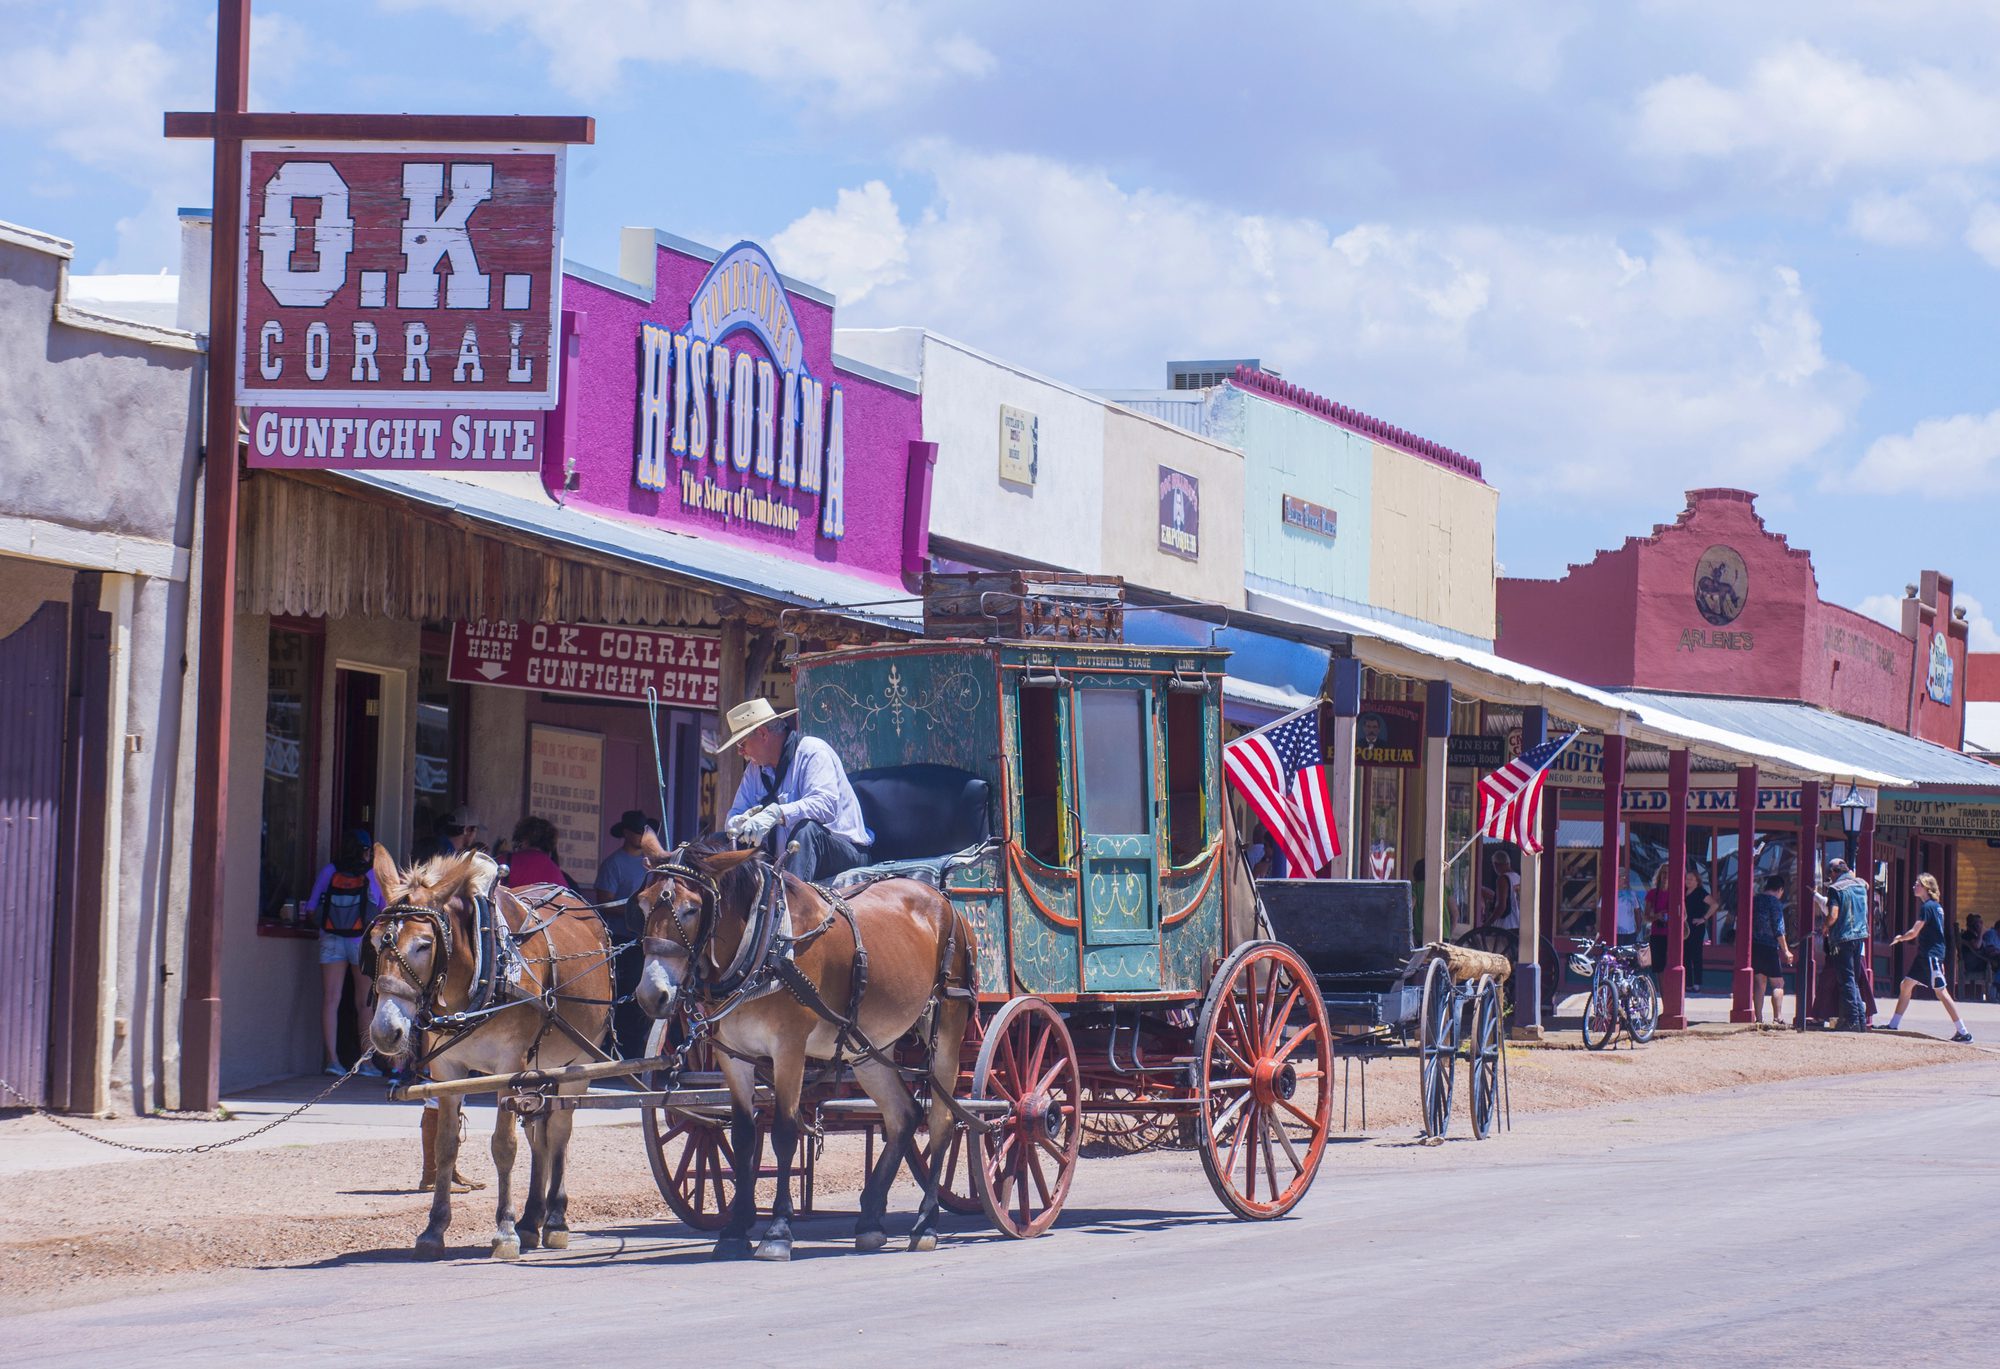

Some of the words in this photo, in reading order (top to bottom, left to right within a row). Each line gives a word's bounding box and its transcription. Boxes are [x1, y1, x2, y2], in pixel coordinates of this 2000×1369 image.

[258, 160, 532, 310] O.K.
[259, 319, 533, 383] CORRAL
[255, 411, 442, 460] GUNFIGHT
[450, 414, 536, 461] SITE
[636, 319, 845, 542] HISTORAMA
[681, 470, 703, 508] The
[703, 475, 733, 523] Story
[733, 486, 746, 519] of
[746, 487, 799, 531] Tombstone
[466, 618, 519, 640] ENTER
[467, 638, 513, 661] HERE
[531, 624, 588, 656] O.K.
[600, 631, 720, 670] CORRAL
[1676, 628, 1754, 652] ARLENE'S
[526, 657, 656, 695] GUNFIGHT
[663, 671, 719, 702] SITE
[1032, 653, 1048, 664] OLD
[1076, 655, 1124, 667] BUTTERFIELD
[1128, 657, 1151, 669] STAGE
[1178, 659, 1195, 670] LINE
[1876, 813, 1918, 826] AUTHENTIC
[1921, 815, 1945, 827] INDIAN
